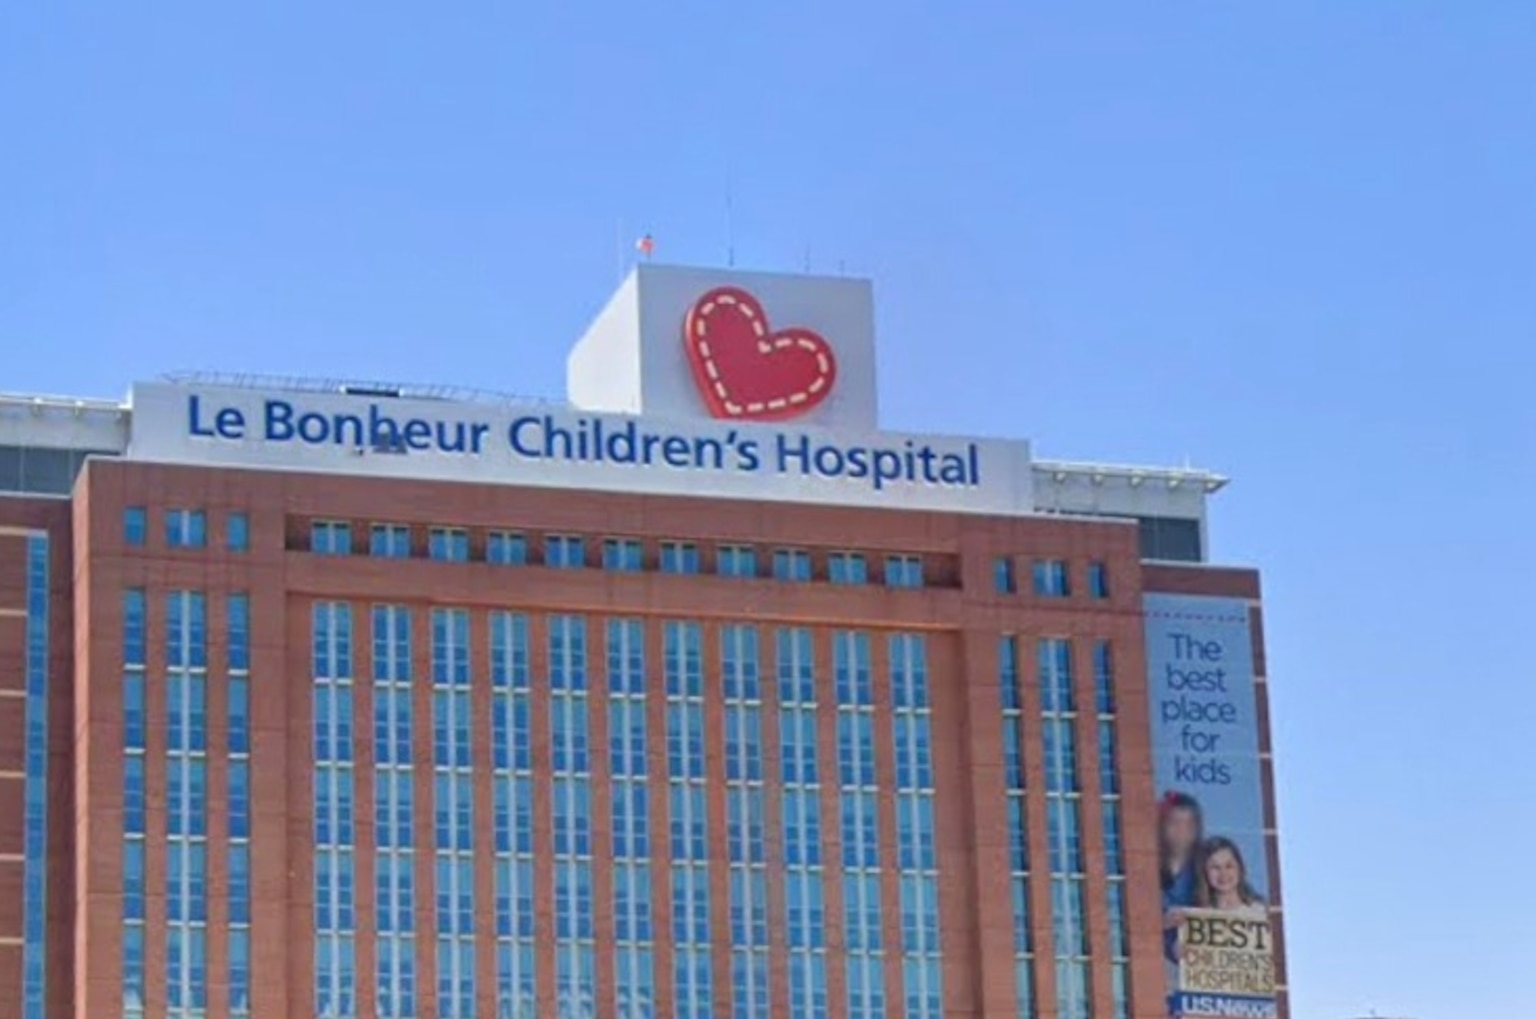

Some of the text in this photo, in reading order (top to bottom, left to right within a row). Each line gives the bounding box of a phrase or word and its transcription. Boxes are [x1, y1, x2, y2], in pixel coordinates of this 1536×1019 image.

[188, 395, 979, 489] Le Bonheur Children's Hospital
[1166, 632, 1223, 661] The
[1165, 664, 1228, 692] best
[1161, 694, 1237, 724] place
[1181, 724, 1220, 752] for
[1174, 755, 1232, 785] kids
[1185, 917, 1269, 950] BEST
[1186, 969, 1274, 992] HOSPITALS
